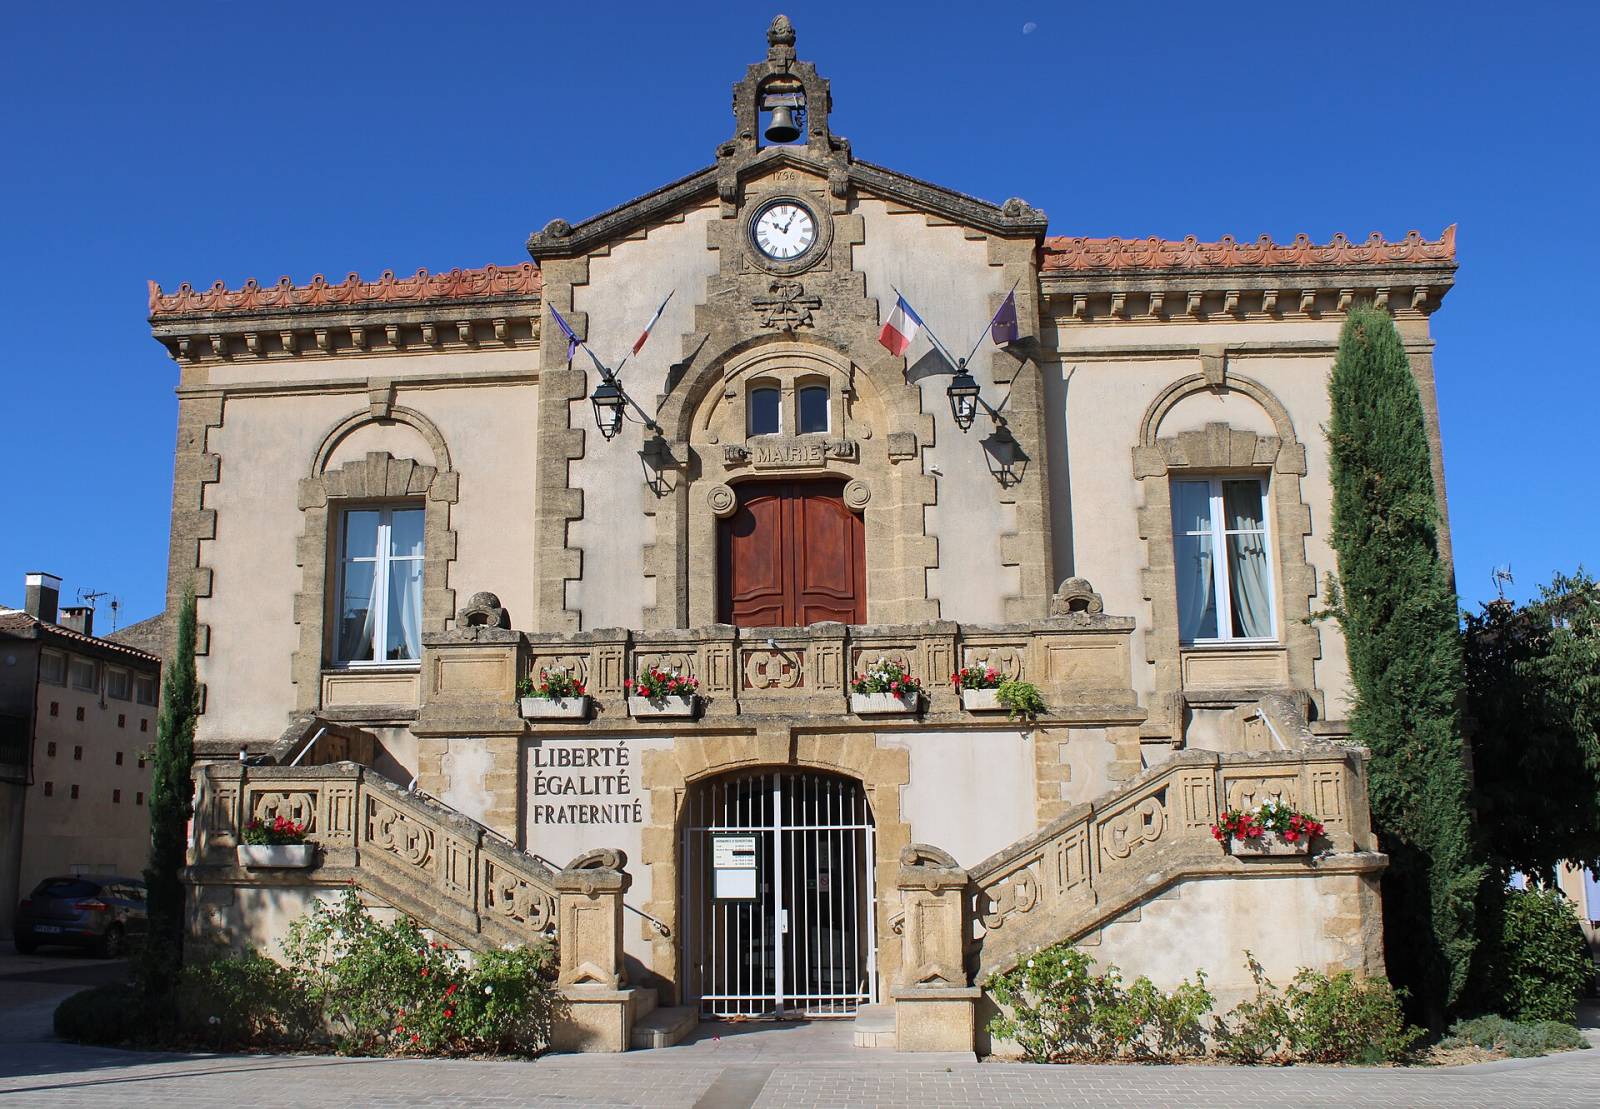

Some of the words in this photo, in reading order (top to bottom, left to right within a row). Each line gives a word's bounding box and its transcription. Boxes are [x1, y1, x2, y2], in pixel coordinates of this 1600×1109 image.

[757, 446, 821, 463] MAIRIE
[534, 741, 630, 768] LIBERTÉ
[534, 769, 631, 796] ÉGALITÉ
[534, 798, 643, 824] FRATERNITÉ
